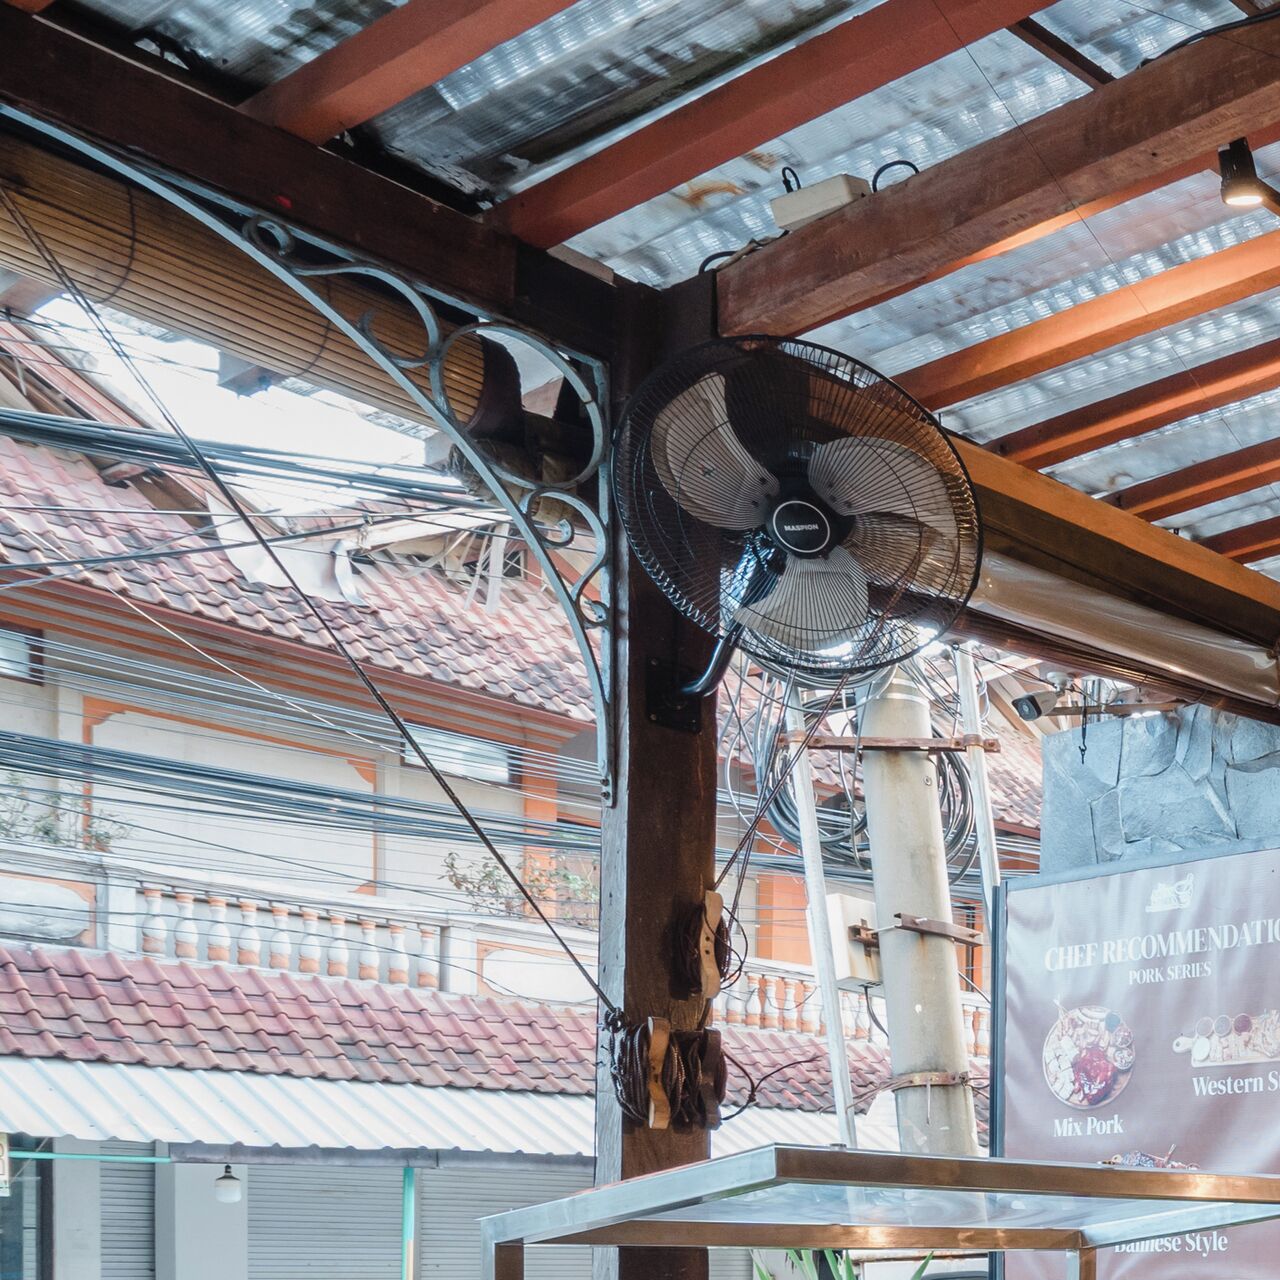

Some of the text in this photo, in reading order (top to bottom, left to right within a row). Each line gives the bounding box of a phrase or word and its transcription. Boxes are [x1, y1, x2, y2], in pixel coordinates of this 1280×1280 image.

[784, 523, 819, 531] MASPION
[1044, 942, 1098, 972] CHEF
[1128, 961, 1212, 986] PORK SERIES
[1192, 1075, 1264, 1097] Western
[1053, 1114, 1124, 1137] Mix Pork
[1185, 1231, 1228, 1257] Style
